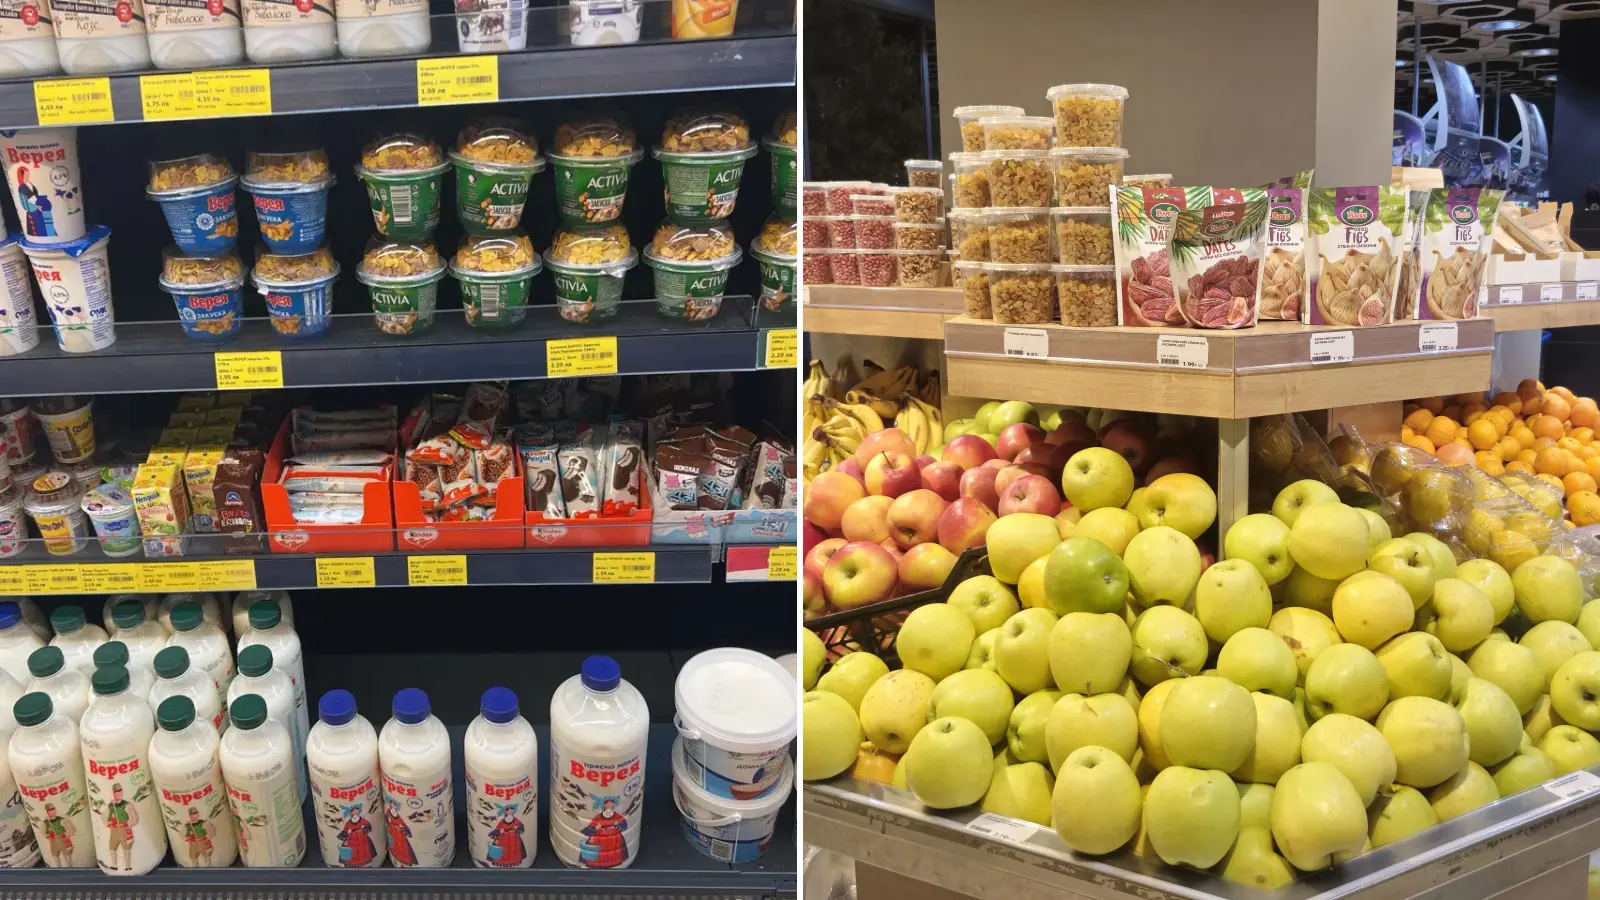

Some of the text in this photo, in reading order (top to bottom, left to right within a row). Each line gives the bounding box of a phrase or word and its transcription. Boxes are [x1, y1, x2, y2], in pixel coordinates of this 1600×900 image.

[7, 147, 66, 169] Верея
[1149, 226, 1168, 242] DAT
[1268, 227, 1292, 242] FIGS
[1345, 227, 1369, 243] FIGS
[1455, 225, 1473, 241] FIGS
[1202, 240, 1237, 256] DATES
[189, 293, 229, 311] Верея
[186, 470, 211, 479] Nesquik
[135, 492, 160, 503] Nesquik
[88, 758, 140, 780] Верея
[570, 759, 640, 787] Верея
[19, 780, 70, 802] Верея
[162, 783, 213, 806] Верея
[329, 778, 373, 801] Верея
[484, 779, 531, 801] Верея
